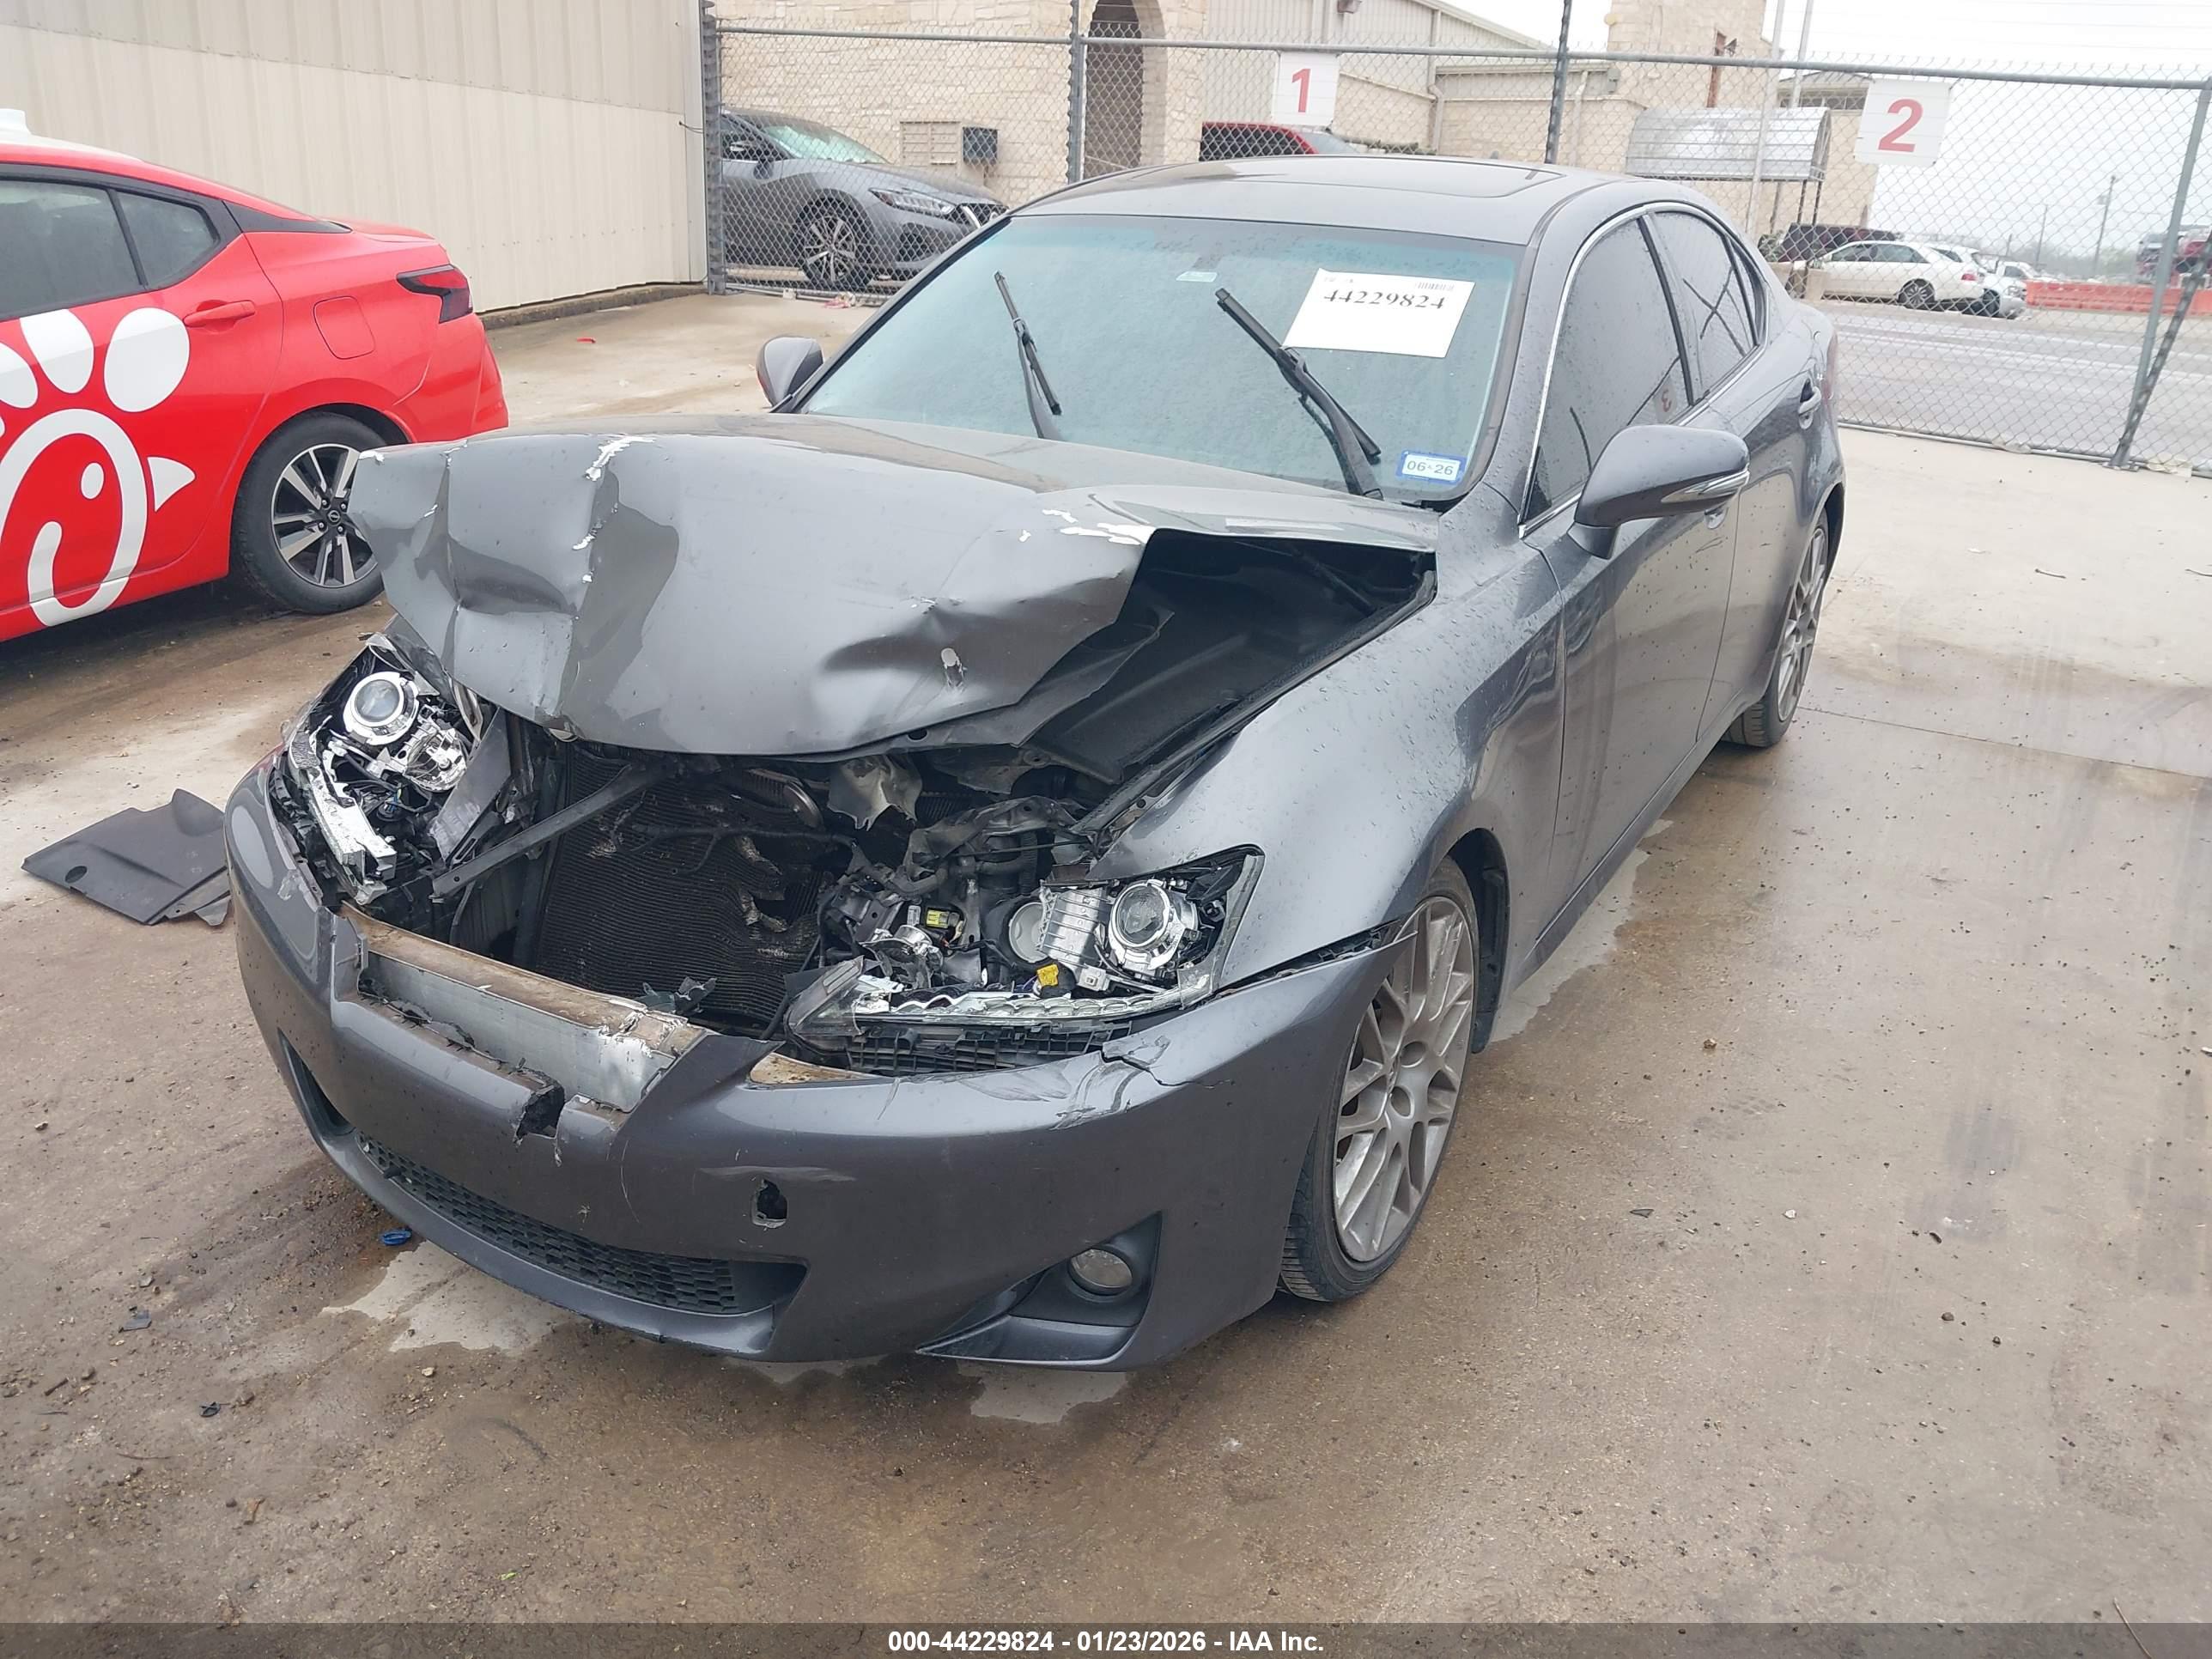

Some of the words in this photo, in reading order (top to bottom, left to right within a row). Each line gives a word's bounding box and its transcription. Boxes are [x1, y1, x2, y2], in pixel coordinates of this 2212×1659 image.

[1291, 68, 1311, 113] 1
[1877, 98, 1923, 153] 2
[1323, 289, 1446, 310] 44229824
